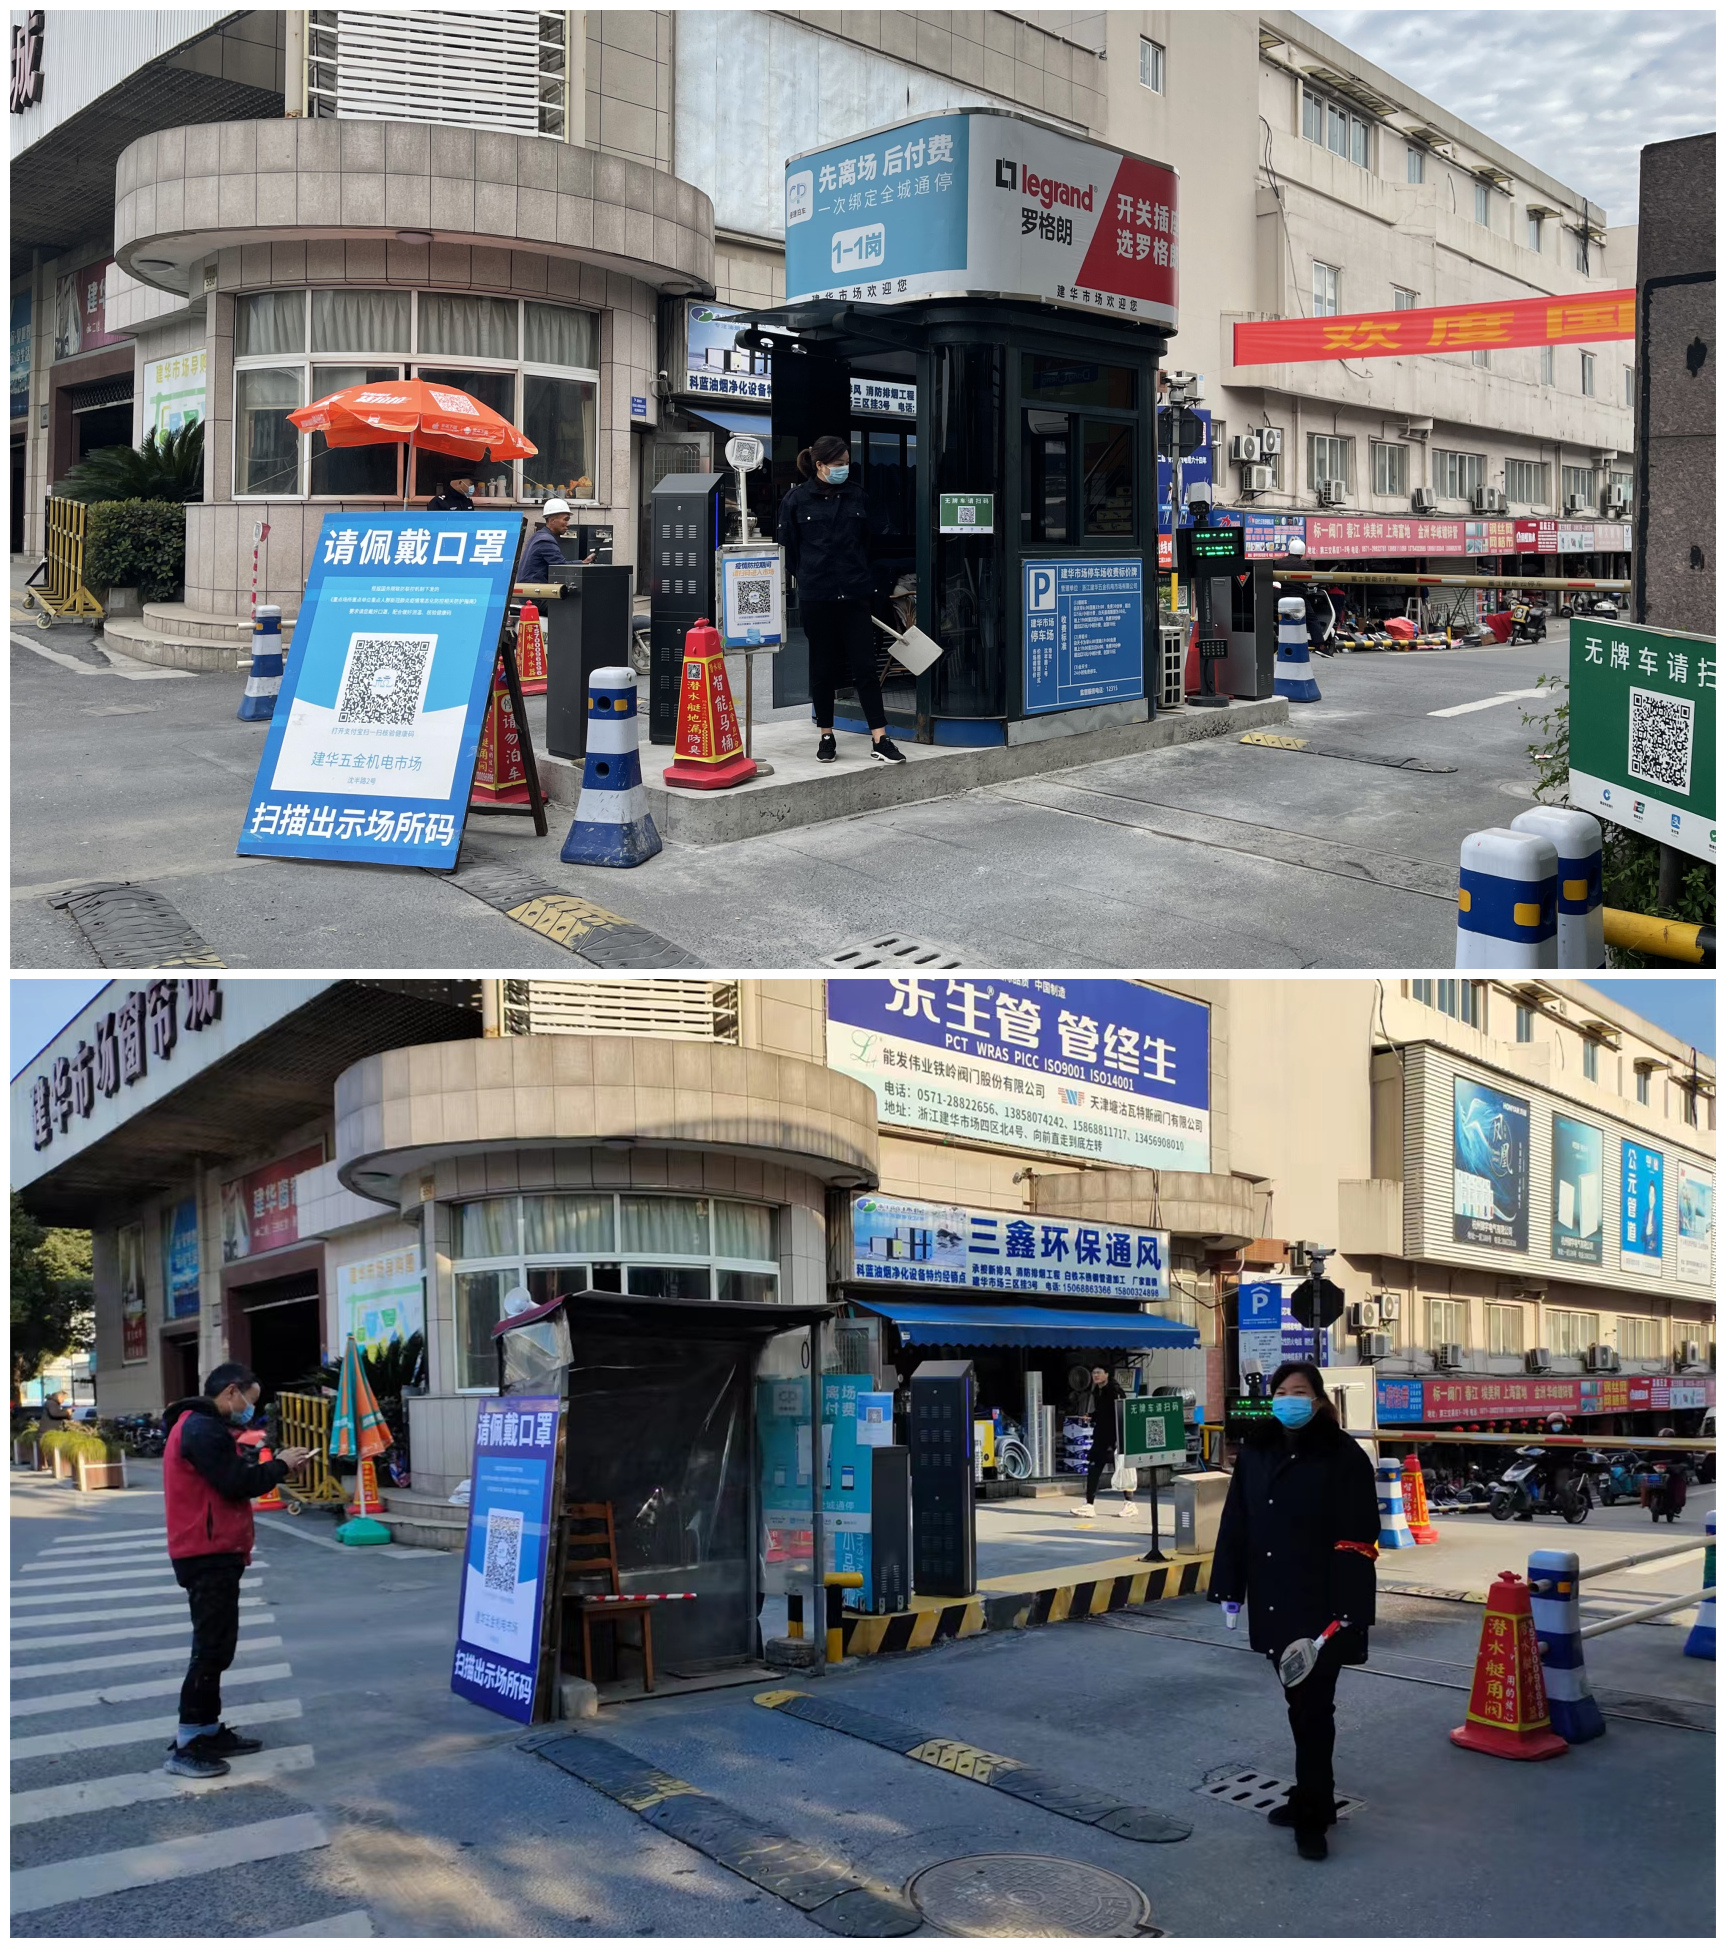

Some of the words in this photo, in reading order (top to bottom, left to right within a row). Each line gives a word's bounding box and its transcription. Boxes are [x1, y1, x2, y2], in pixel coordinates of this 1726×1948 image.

[818, 153, 878, 194] 先离场
[882, 132, 954, 177] 后付费
[818, 171, 953, 216] 一次绑定全城通停
[1021, 163, 1094, 213] legrand
[1021, 206, 1073, 246] 罗格朗
[832, 231, 882, 265] 1-1岗
[1056, 283, 1139, 312] 建华市场欢迎您
[1322, 299, 1636, 352] 欢度国
[865, 385, 915, 401] 消防排烟工程
[323, 527, 508, 566] 请佩戴口罩
[1313, 521, 1343, 539] 标一阀门
[1034, 571, 1051, 608] P
[1060, 566, 1138, 580] 建华市场停车场收费标价牌
[1030, 617, 1055, 628] 建华市场
[1030, 629, 1055, 643] 停车场
[712, 674, 734, 752] 智能马桶
[331, 727, 415, 738] 打开支付宝扫一扫核验健康码
[502, 714, 521, 780] 请勿泊车
[311, 751, 423, 773] 建华五金机电市场
[346, 776, 377, 786] 沈半路2号
[250, 801, 455, 847] 扫描出示场所码
[1034, 980, 1067, 999] 中国制造
[945, 1032, 969, 1053] PCT
[976, 1039, 1010, 1062] WRAS
[1014, 1049, 1040, 1071] PICC
[1044, 1056, 1086, 1080] ISO9001
[1089, 1067, 1135, 1092] ISO14001
[1057, 1009, 1177, 1085] 管终生
[882, 1048, 1046, 1099] 能发伟业铁岭阀门股份有限公司
[1089, 1094, 1204, 1133] 天津塘沽瓦特斯阀门有限公司
[967, 1216, 1162, 1271] 三鑫环保通风
[856, 1263, 967, 1284] 科蓝油烟净化设备特约经销点
[971, 1276, 1038, 1291] 建华市场三区挂3号
[1016, 1266, 1061, 1280] 消防排烟工程
[1064, 1270, 1126, 1285] 白铁不锈钢管道加工
[1132, 1275, 1158, 1287] 厂家直销
[1252, 1293, 1269, 1315] P
[825, 1385, 857, 1400] 离场
[825, 1401, 857, 1418] 付费
[1130, 1401, 1179, 1415] 无牌车请扫码
[476, 1412, 552, 1448] 请佩戴口罩
[454, 1648, 533, 1706] 扫描出示场所码
[1484, 1618, 1507, 1720] 潜水艇角阀
